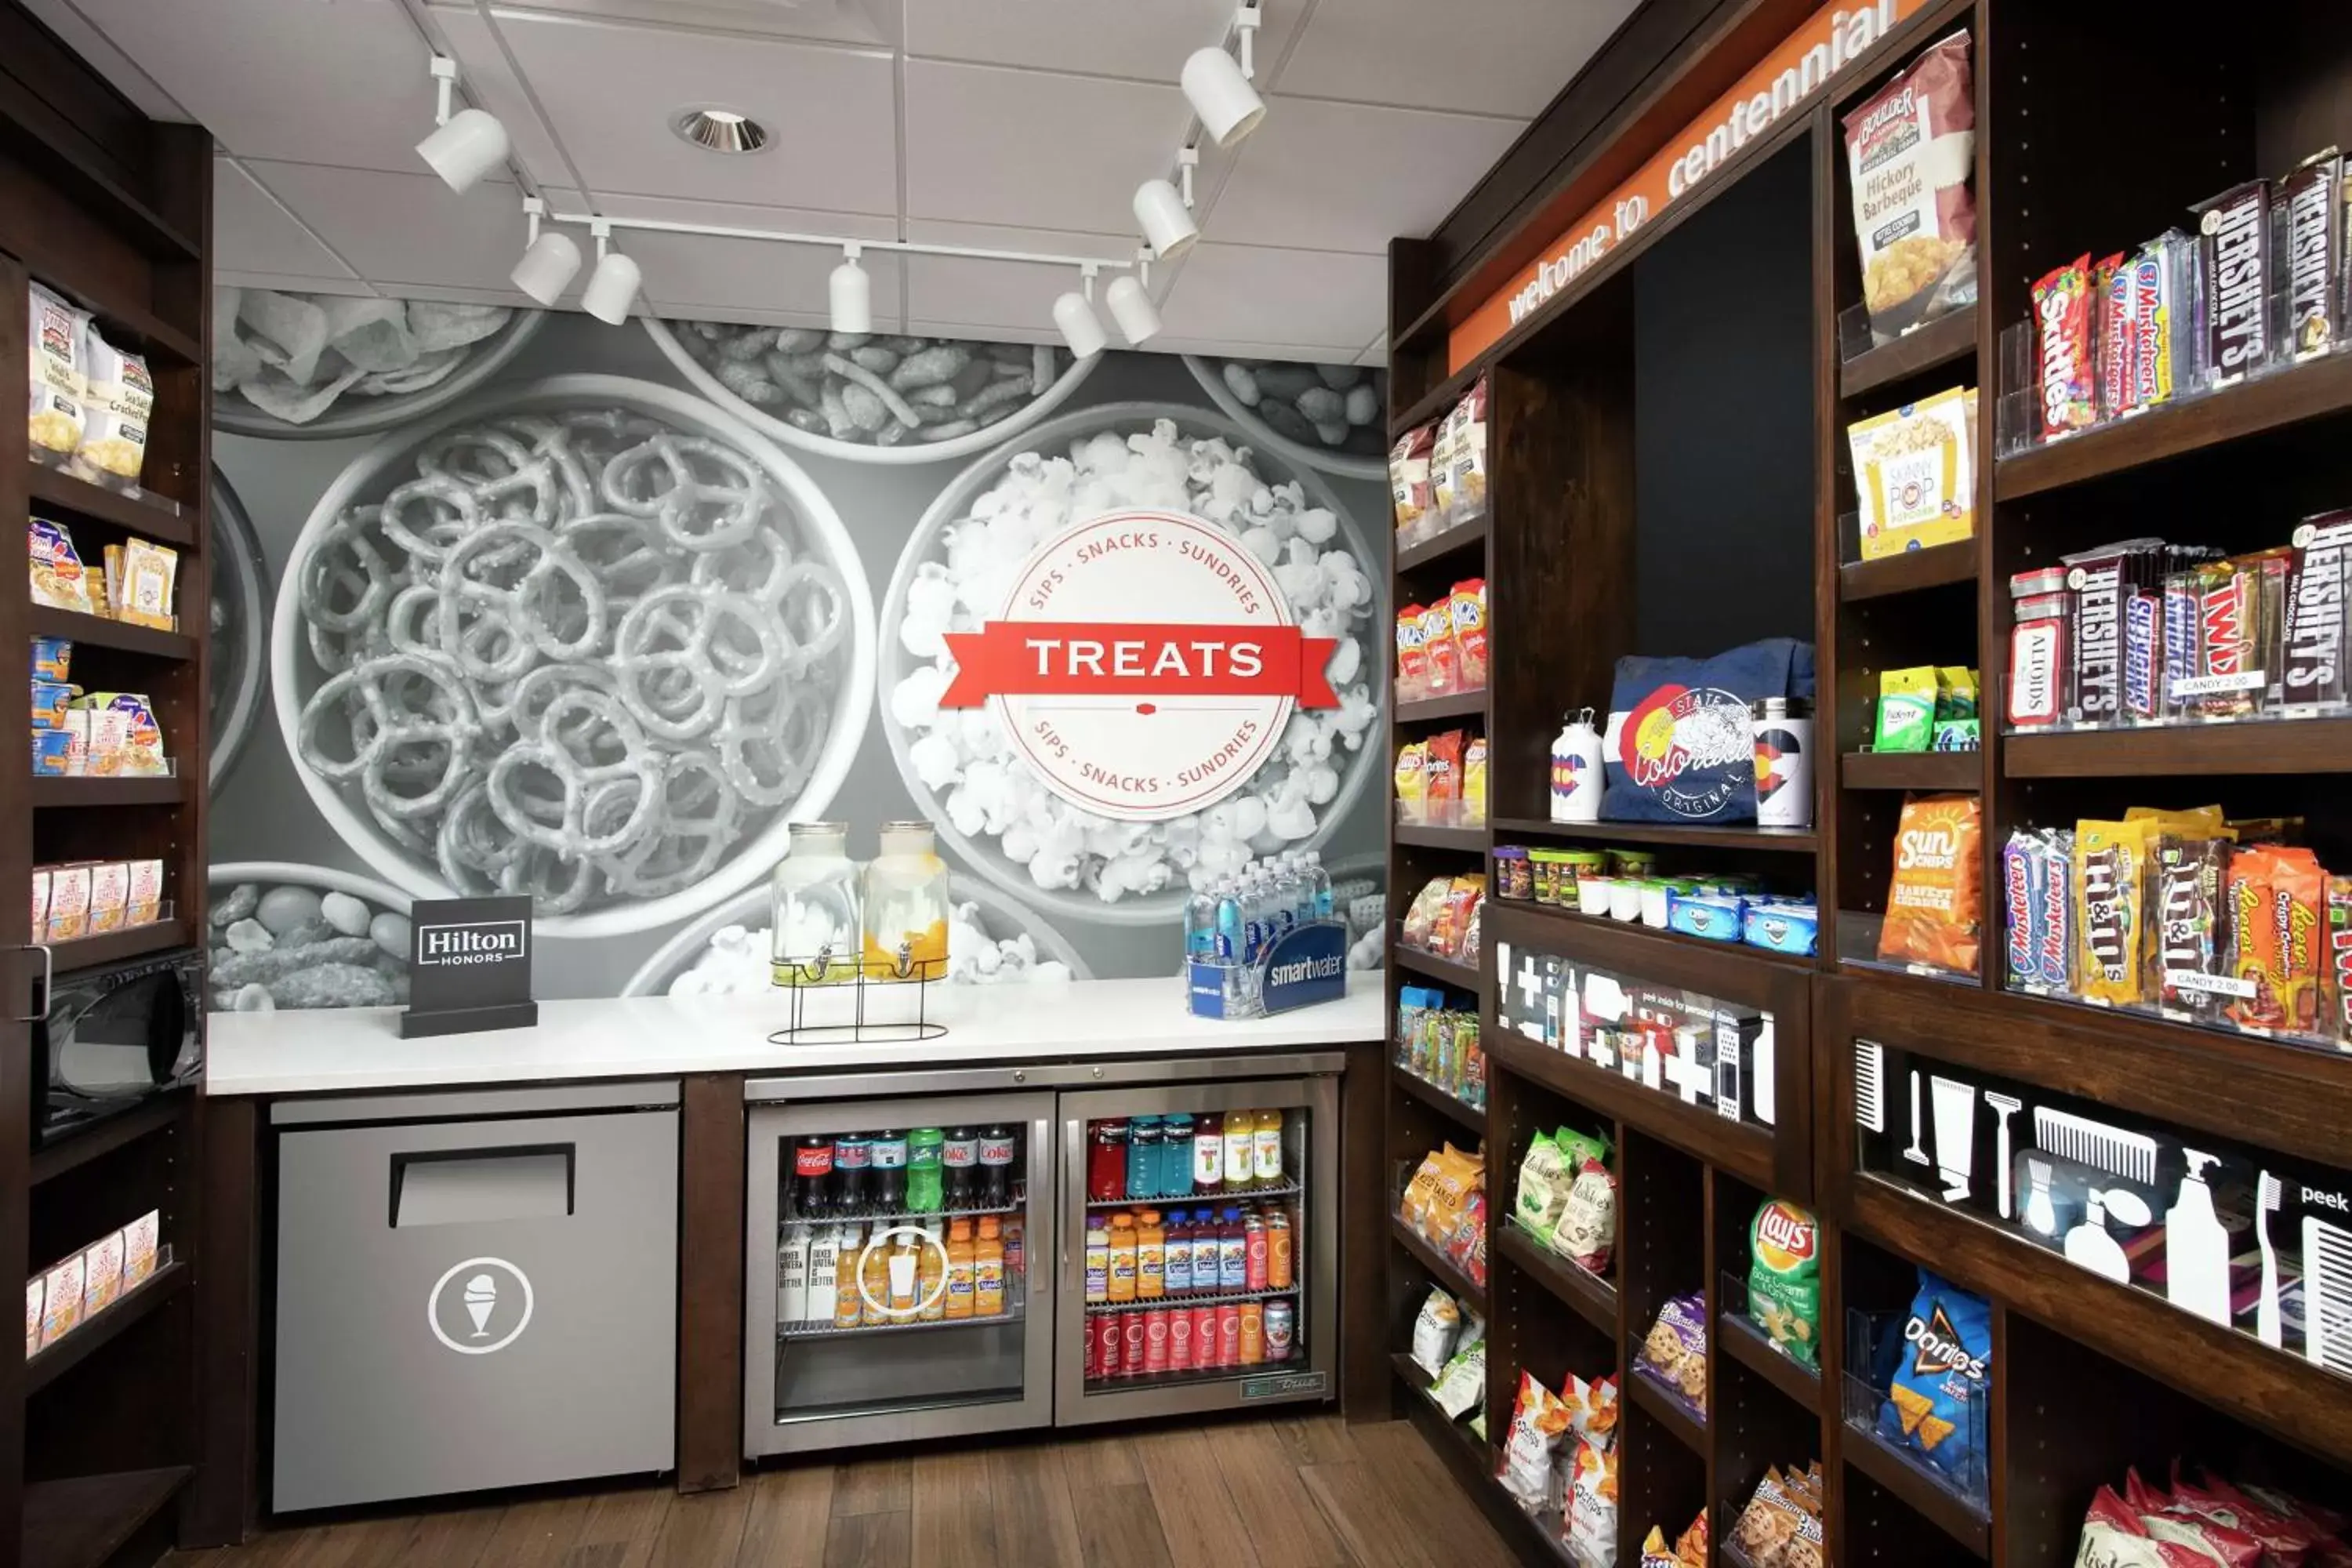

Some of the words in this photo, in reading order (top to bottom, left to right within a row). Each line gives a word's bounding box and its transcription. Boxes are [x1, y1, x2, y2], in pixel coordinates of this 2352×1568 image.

[1509, 223, 1610, 325] welcome
[1614, 195, 1649, 240] to
[1668, 0, 1897, 198] centennial
[1867, 162, 1915, 198] Hickory
[1864, 179, 1922, 220] Barbeque
[2291, 180, 2328, 328] HERSHEY'S
[2218, 198, 2263, 366] HERSHEY'S
[2041, 292, 2076, 426] Skittles
[2139, 288, 2158, 397] Musketeers
[1029, 569, 1065, 611] SIPS
[1076, 533, 1159, 565] SNACKS
[1178, 539, 1261, 615] SUNDRIES
[2286, 524, 2352, 687] HERSHEY'S
[1025, 638, 1263, 677] TREATS
[2082, 571, 2118, 712] HERSHEY'S
[2029, 636, 2045, 710] ALTOIDS
[2184, 681, 2221, 691] CANDY
[1677, 693, 1722, 713] STATE
[1034, 720, 1069, 758] SIPS
[1080, 762, 1159, 793] SNACKS
[1178, 719, 1258, 788] SUNDRIES
[1635, 742, 1754, 786] Colorado
[1663, 774, 1741, 813] ORIGINAL
[1899, 829, 1957, 869] Sun
[1914, 855, 1955, 869] CHIPS
[2009, 856, 2029, 955] Musketeers
[2044, 861, 2062, 963] Musketeers
[2277, 891, 2290, 928] Crispy
[428, 930, 515, 954] Hilton
[441, 953, 503, 966] HONORS
[1271, 953, 1342, 987] smartwater
[2177, 975, 2213, 986] CANDY
[2301, 1185, 2349, 1212] peek
[1905, 1317, 1986, 1379] Doritos
